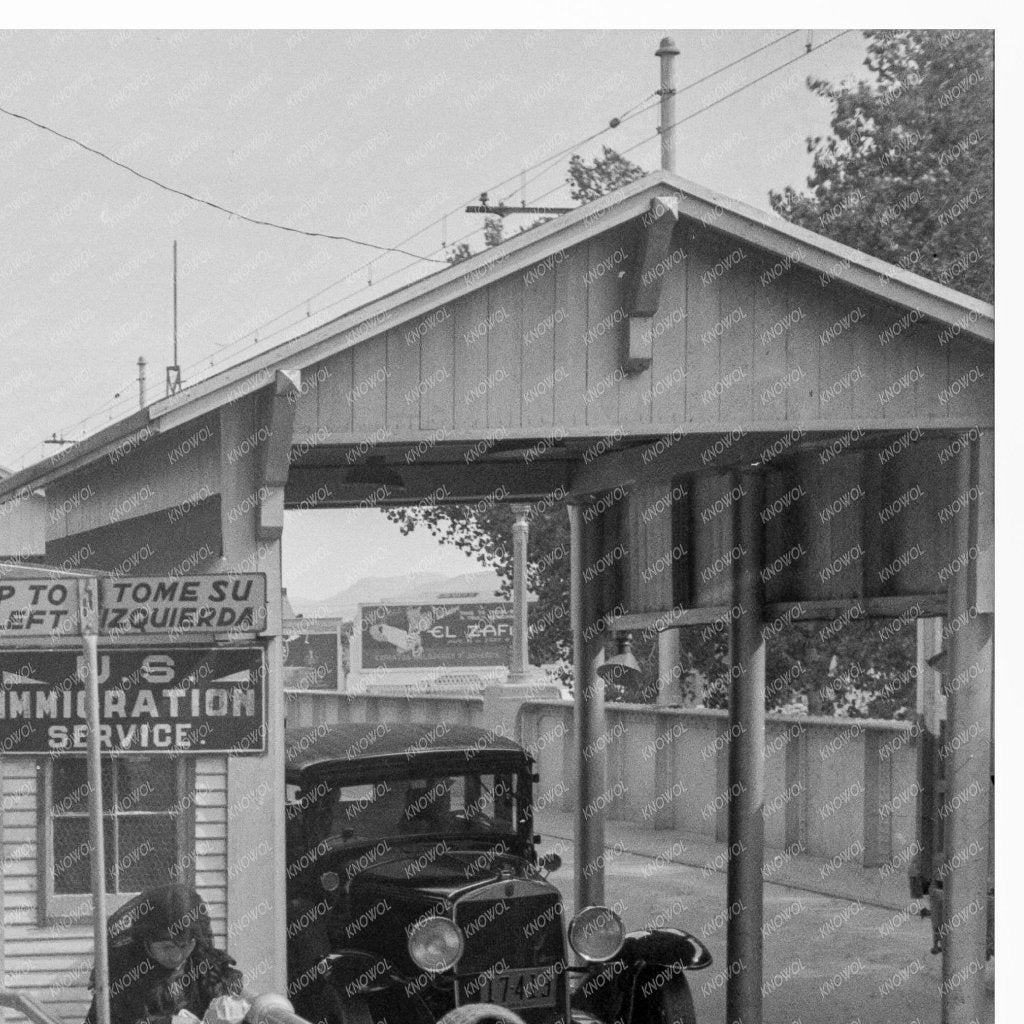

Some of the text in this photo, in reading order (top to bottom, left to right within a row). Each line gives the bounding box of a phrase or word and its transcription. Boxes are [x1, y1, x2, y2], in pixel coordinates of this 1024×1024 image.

[28, 584, 68, 606] TO
[113, 580, 254, 603] TOME SU
[101, 606, 254, 633] IZQUIERDA
[427, 626, 457, 638] EL
